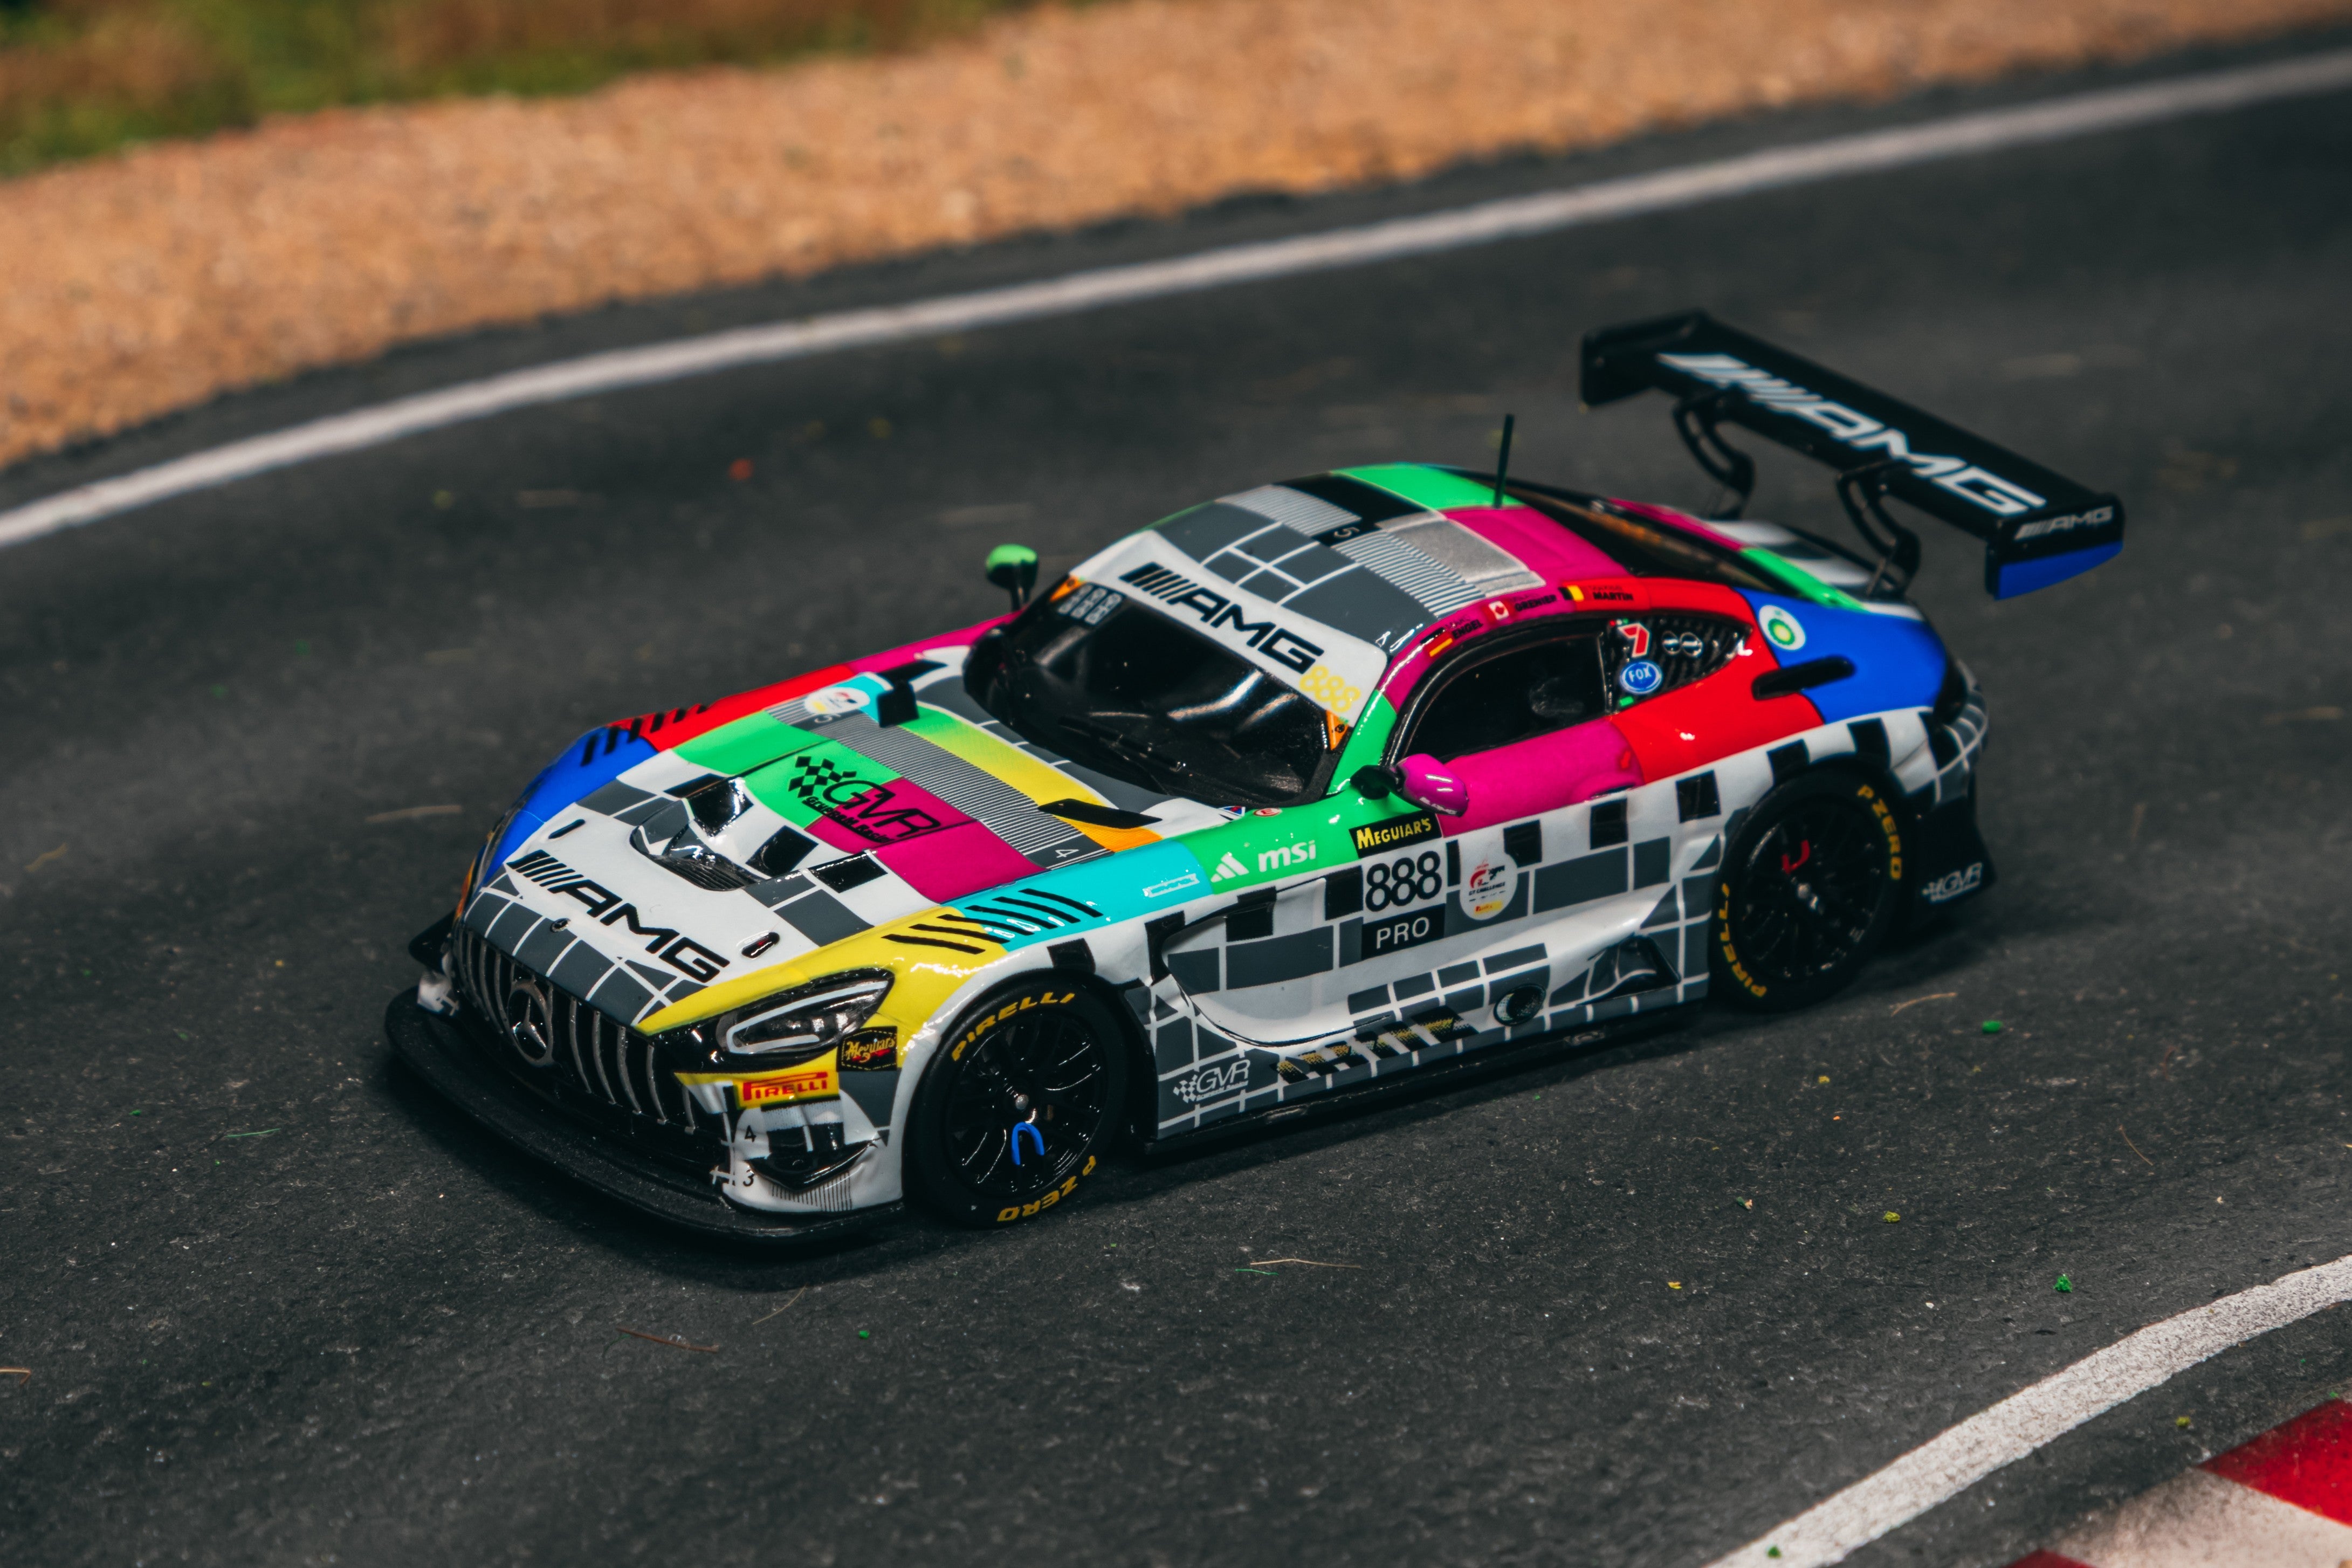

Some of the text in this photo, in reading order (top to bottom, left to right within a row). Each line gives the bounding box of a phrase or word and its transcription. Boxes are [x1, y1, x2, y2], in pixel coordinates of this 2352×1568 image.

[1766, 401, 2047, 516] AMG
[1334, 527, 1360, 537] 5
[1514, 594, 1557, 612] GRENIER
[1592, 591, 1634, 601] MARTIN
[1167, 588, 1324, 674] AMG
[1453, 618, 1484, 639] ENGEL
[1299, 665, 1361, 713] 888
[1628, 665, 1652, 683] FOX
[822, 780, 941, 838] GVR
[1356, 817, 1432, 850] MEGUIAR'S
[1857, 785, 1902, 881] P ZERO
[1055, 849, 1079, 858] 4
[1258, 840, 1316, 872] msi
[1365, 850, 1442, 912] 888
[549, 878, 730, 984] AMG
[1376, 917, 1429, 949] PRO
[1718, 882, 1767, 997] PIRELLI
[952, 992, 1075, 1061] PIRELLI
[742, 1071, 828, 1101] PIRELLI
[1196, 1059, 1251, 1094] GVR
[744, 1125, 757, 1143] 4
[742, 1173, 755, 1187] 3
[997, 1155, 1096, 1221] P ZERO
